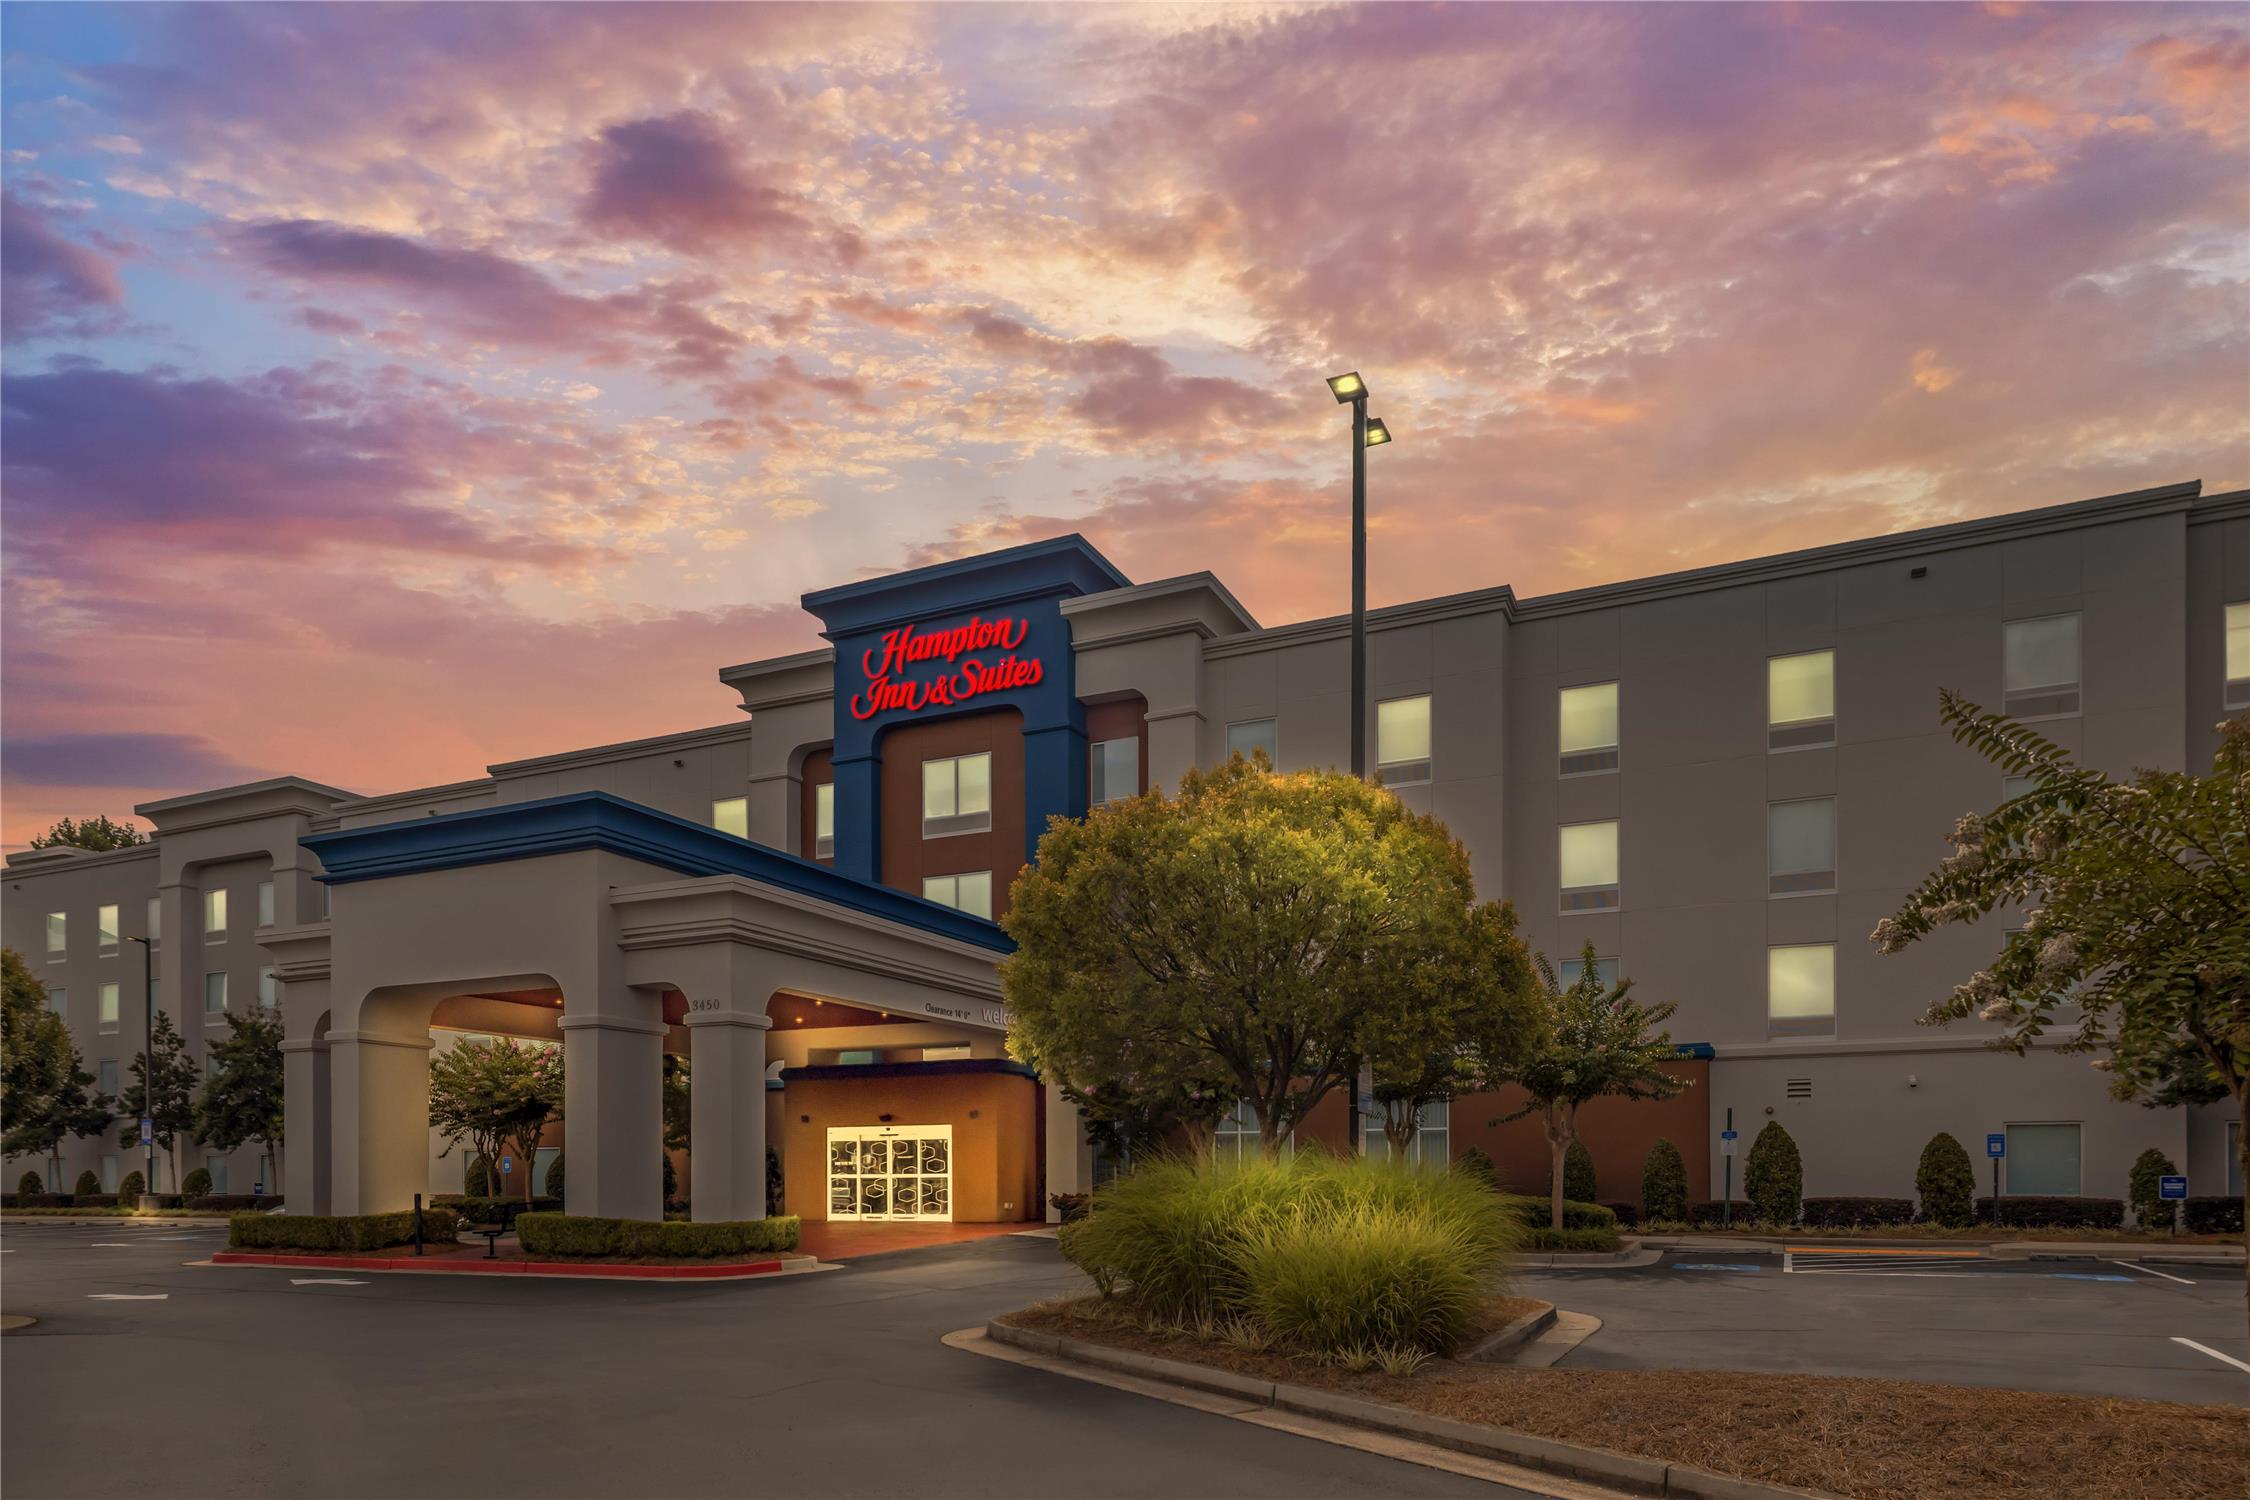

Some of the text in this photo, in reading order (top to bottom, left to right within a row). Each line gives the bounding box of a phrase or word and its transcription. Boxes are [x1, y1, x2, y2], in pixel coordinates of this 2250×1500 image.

[863, 616, 1028, 680] Hampton
[851, 655, 1043, 720] Inn & Suites
[692, 999, 720, 1011] 3450
[924, 1002, 953, 1017] Clearance
